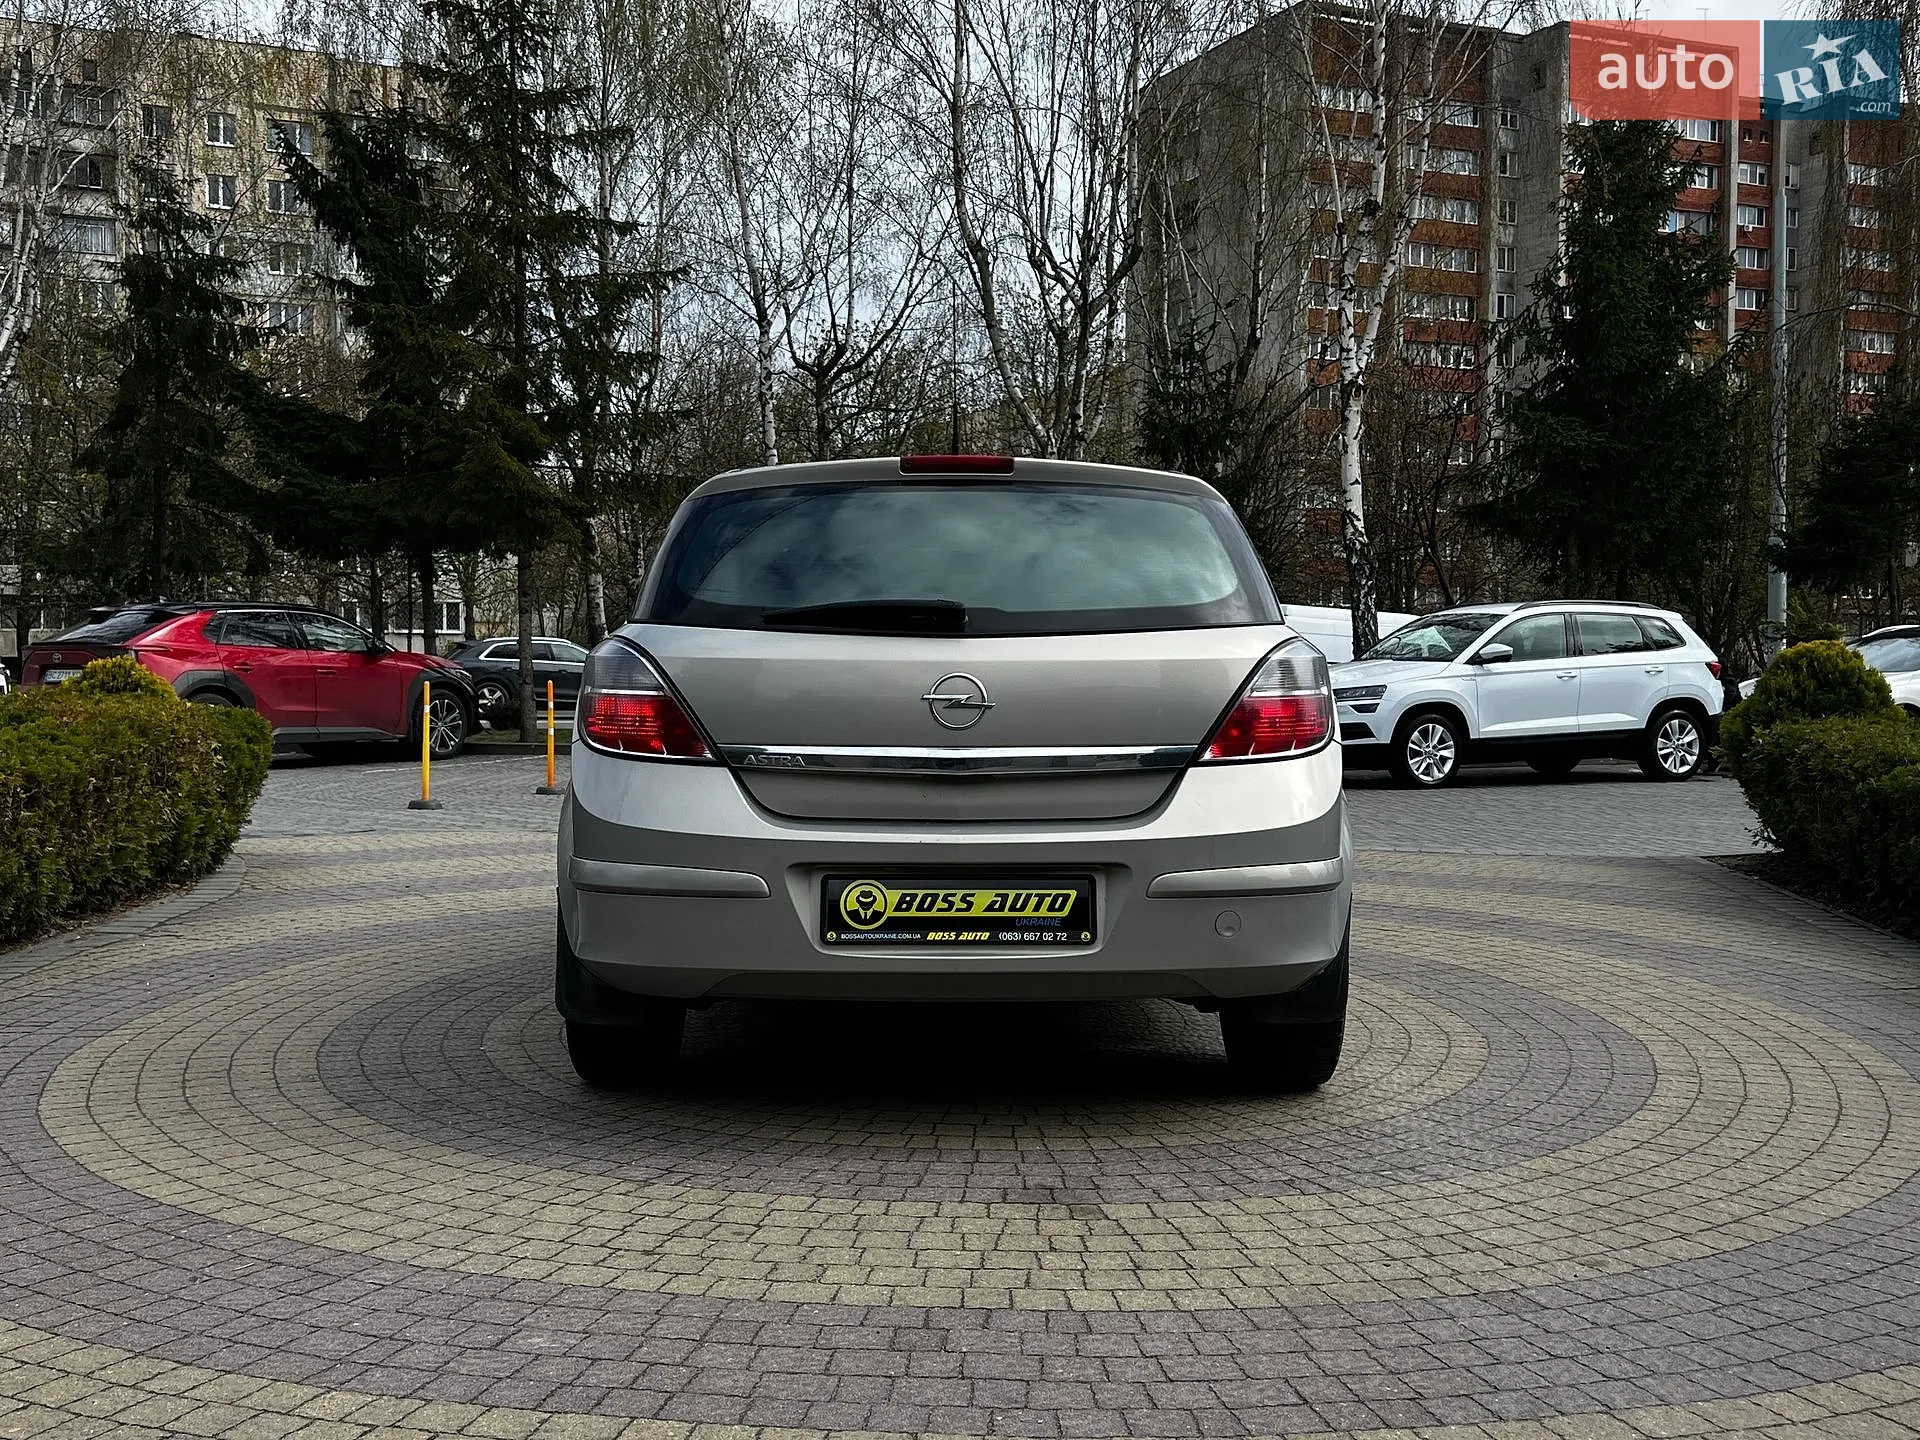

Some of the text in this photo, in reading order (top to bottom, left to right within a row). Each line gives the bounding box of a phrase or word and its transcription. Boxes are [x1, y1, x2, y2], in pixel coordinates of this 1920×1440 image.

[743, 754, 806, 767] ASTRA
[892, 892, 1072, 913] BOSS AUTO
[1015, 918, 1062, 927] UKRAINE
[926, 931, 956, 940] BOSS
[998, 932, 1067, 942] (063) 667 02 72
